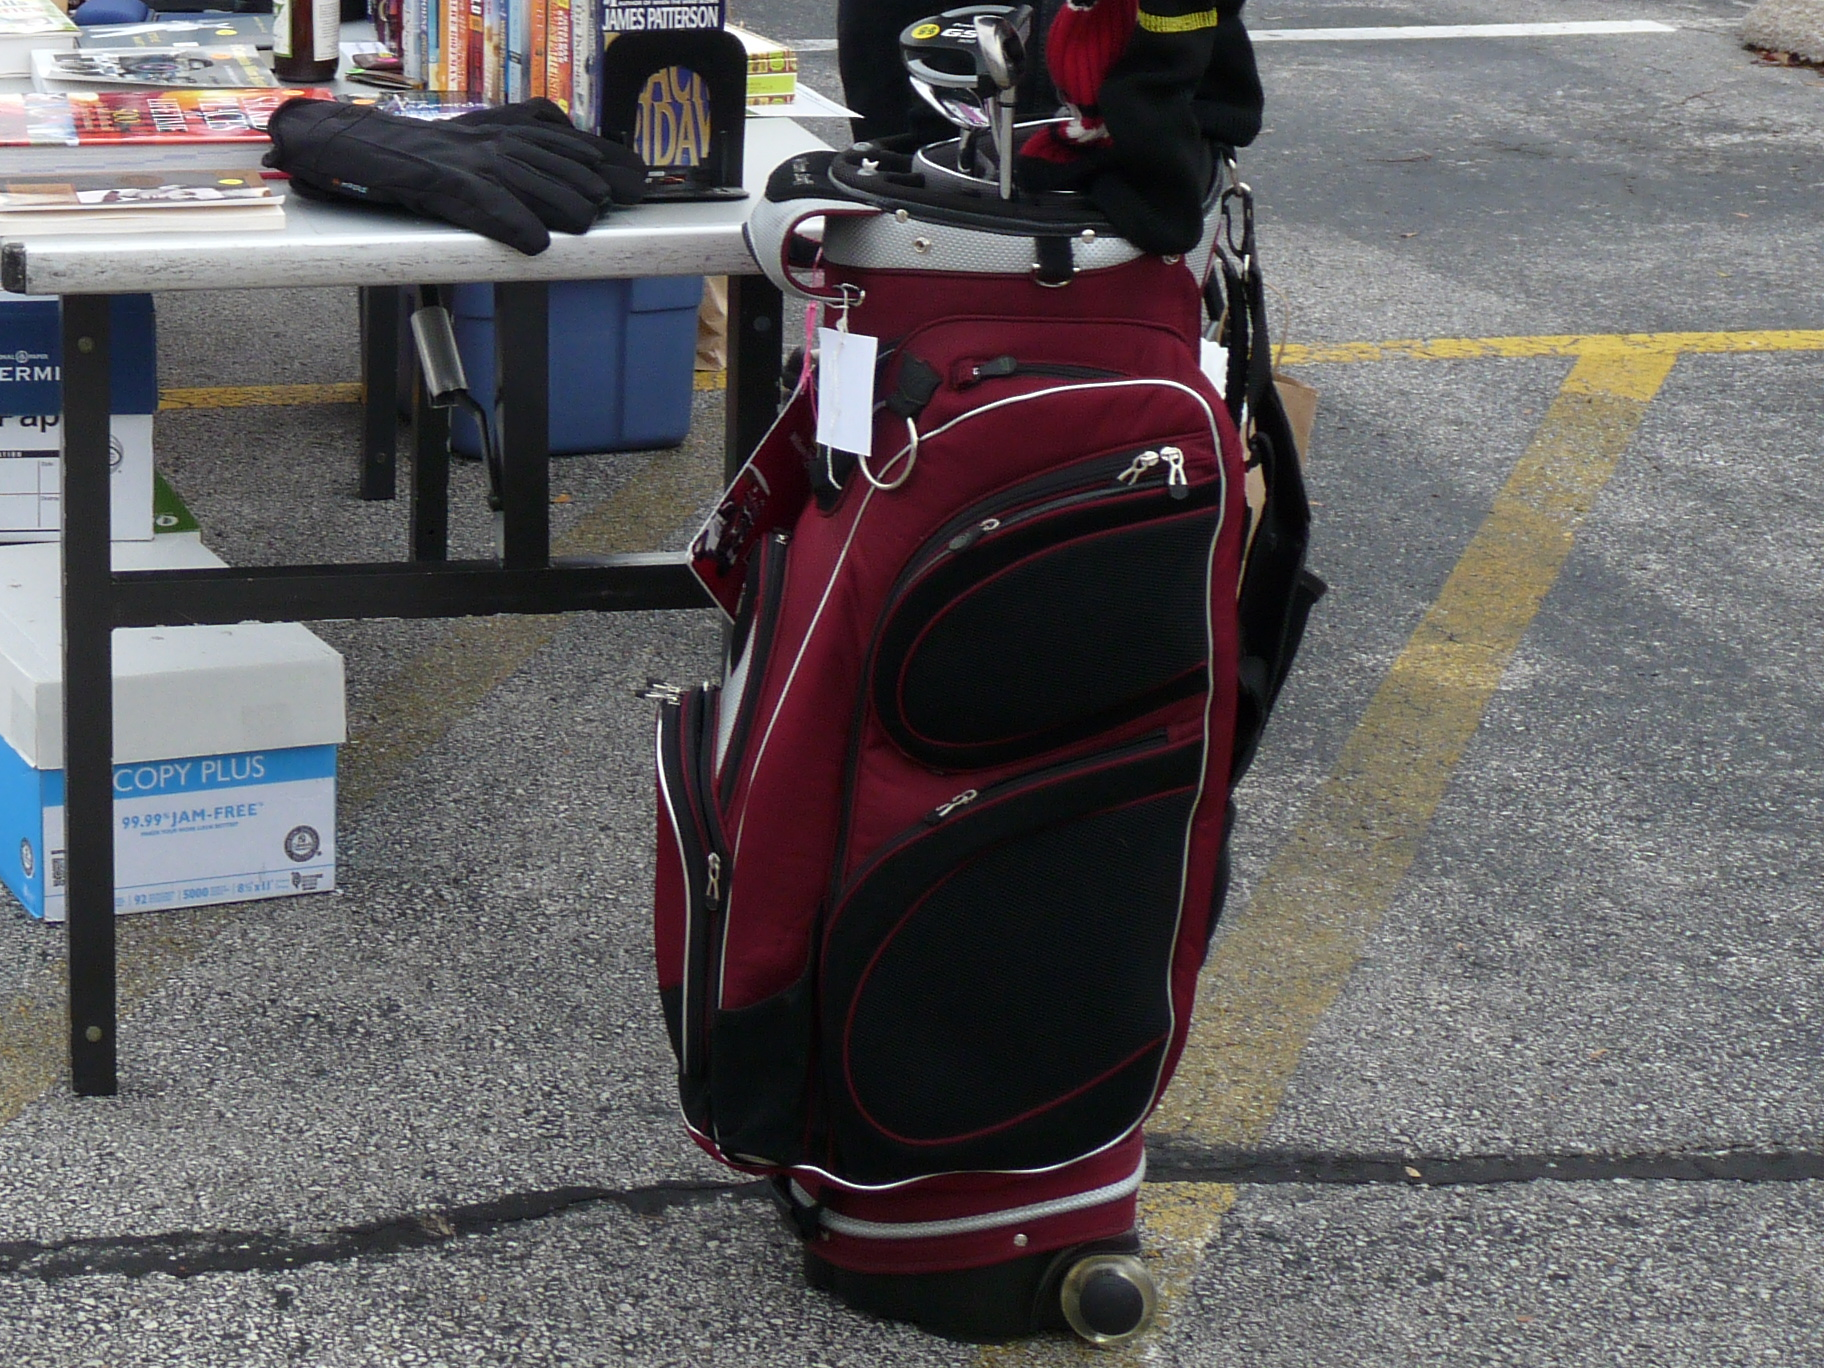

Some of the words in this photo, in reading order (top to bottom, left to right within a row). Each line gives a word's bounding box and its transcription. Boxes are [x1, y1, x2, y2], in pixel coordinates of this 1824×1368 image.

[602, 8, 645, 30] JAMES
[647, 6, 719, 29] PATTERSON
[114, 762, 192, 792] COPY
[202, 755, 265, 783] PLUS
[134, 894, 147, 905] 92
[182, 888, 209, 900] 5000
